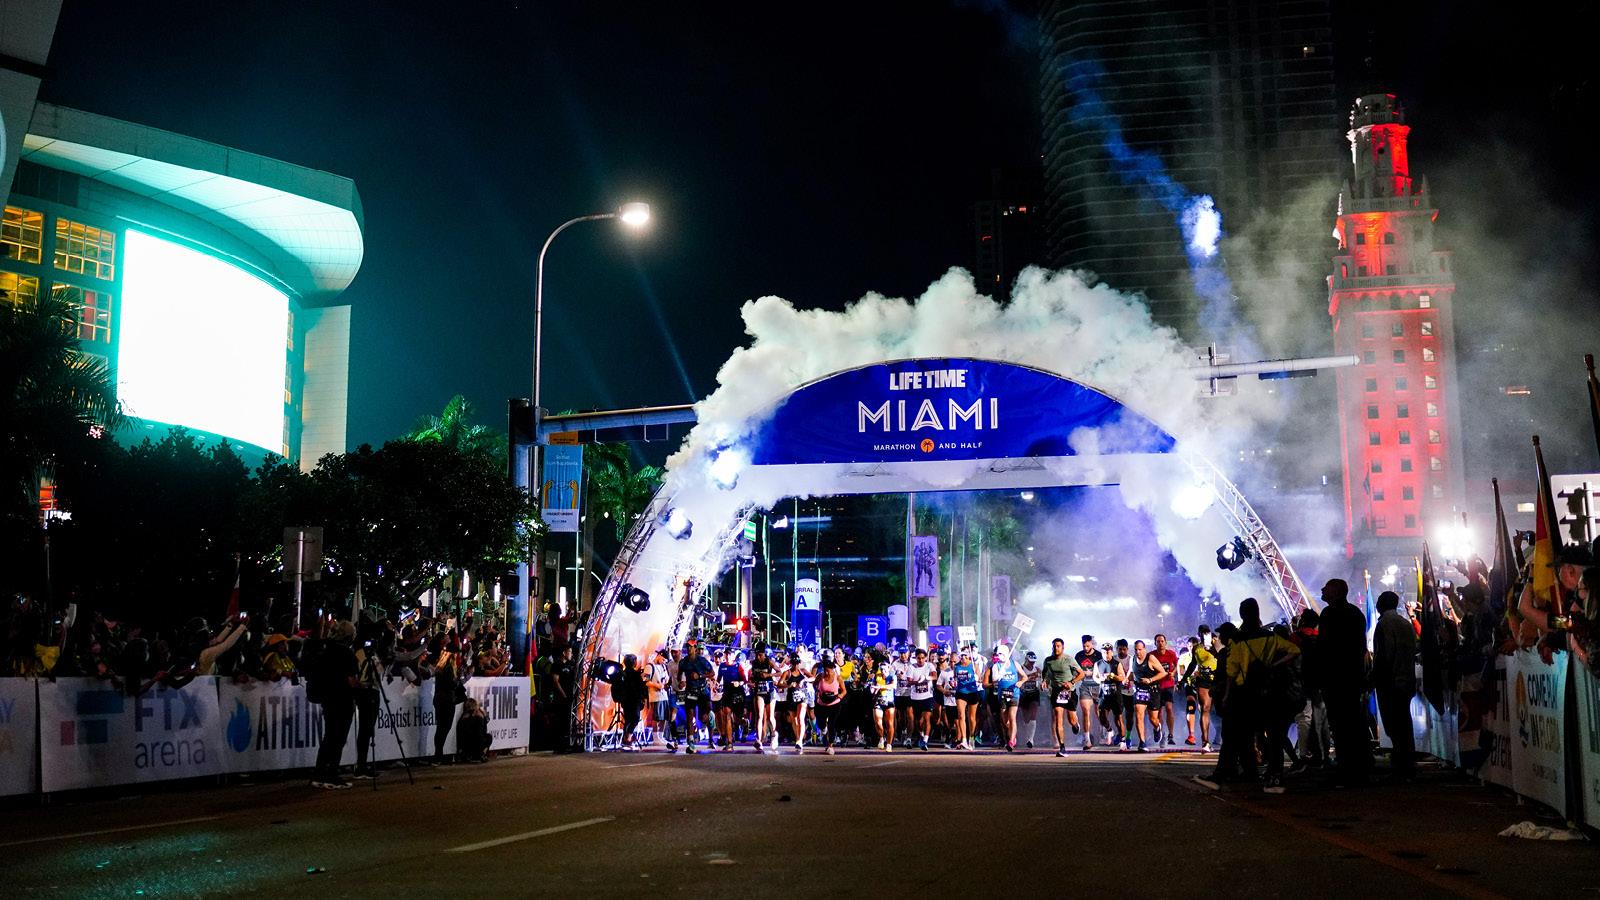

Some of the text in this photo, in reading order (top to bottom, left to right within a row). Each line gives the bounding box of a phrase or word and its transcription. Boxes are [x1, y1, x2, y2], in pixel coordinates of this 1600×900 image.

[890, 370, 966, 390] LIFE TIME
[858, 398, 998, 432] MIAMI
[873, 443, 916, 451] MARATHON
[797, 595, 807, 608] A
[867, 622, 879, 636] B
[936, 631, 945, 642] C
[135, 688, 202, 731] FTX
[492, 686, 518, 719] TIME
[256, 696, 322, 750] ATHLIN
[378, 706, 438, 734] Baptist Hea
[501, 728, 507, 739] OF
[508, 728, 518, 738] LIFE
[135, 738, 206, 769] arena
